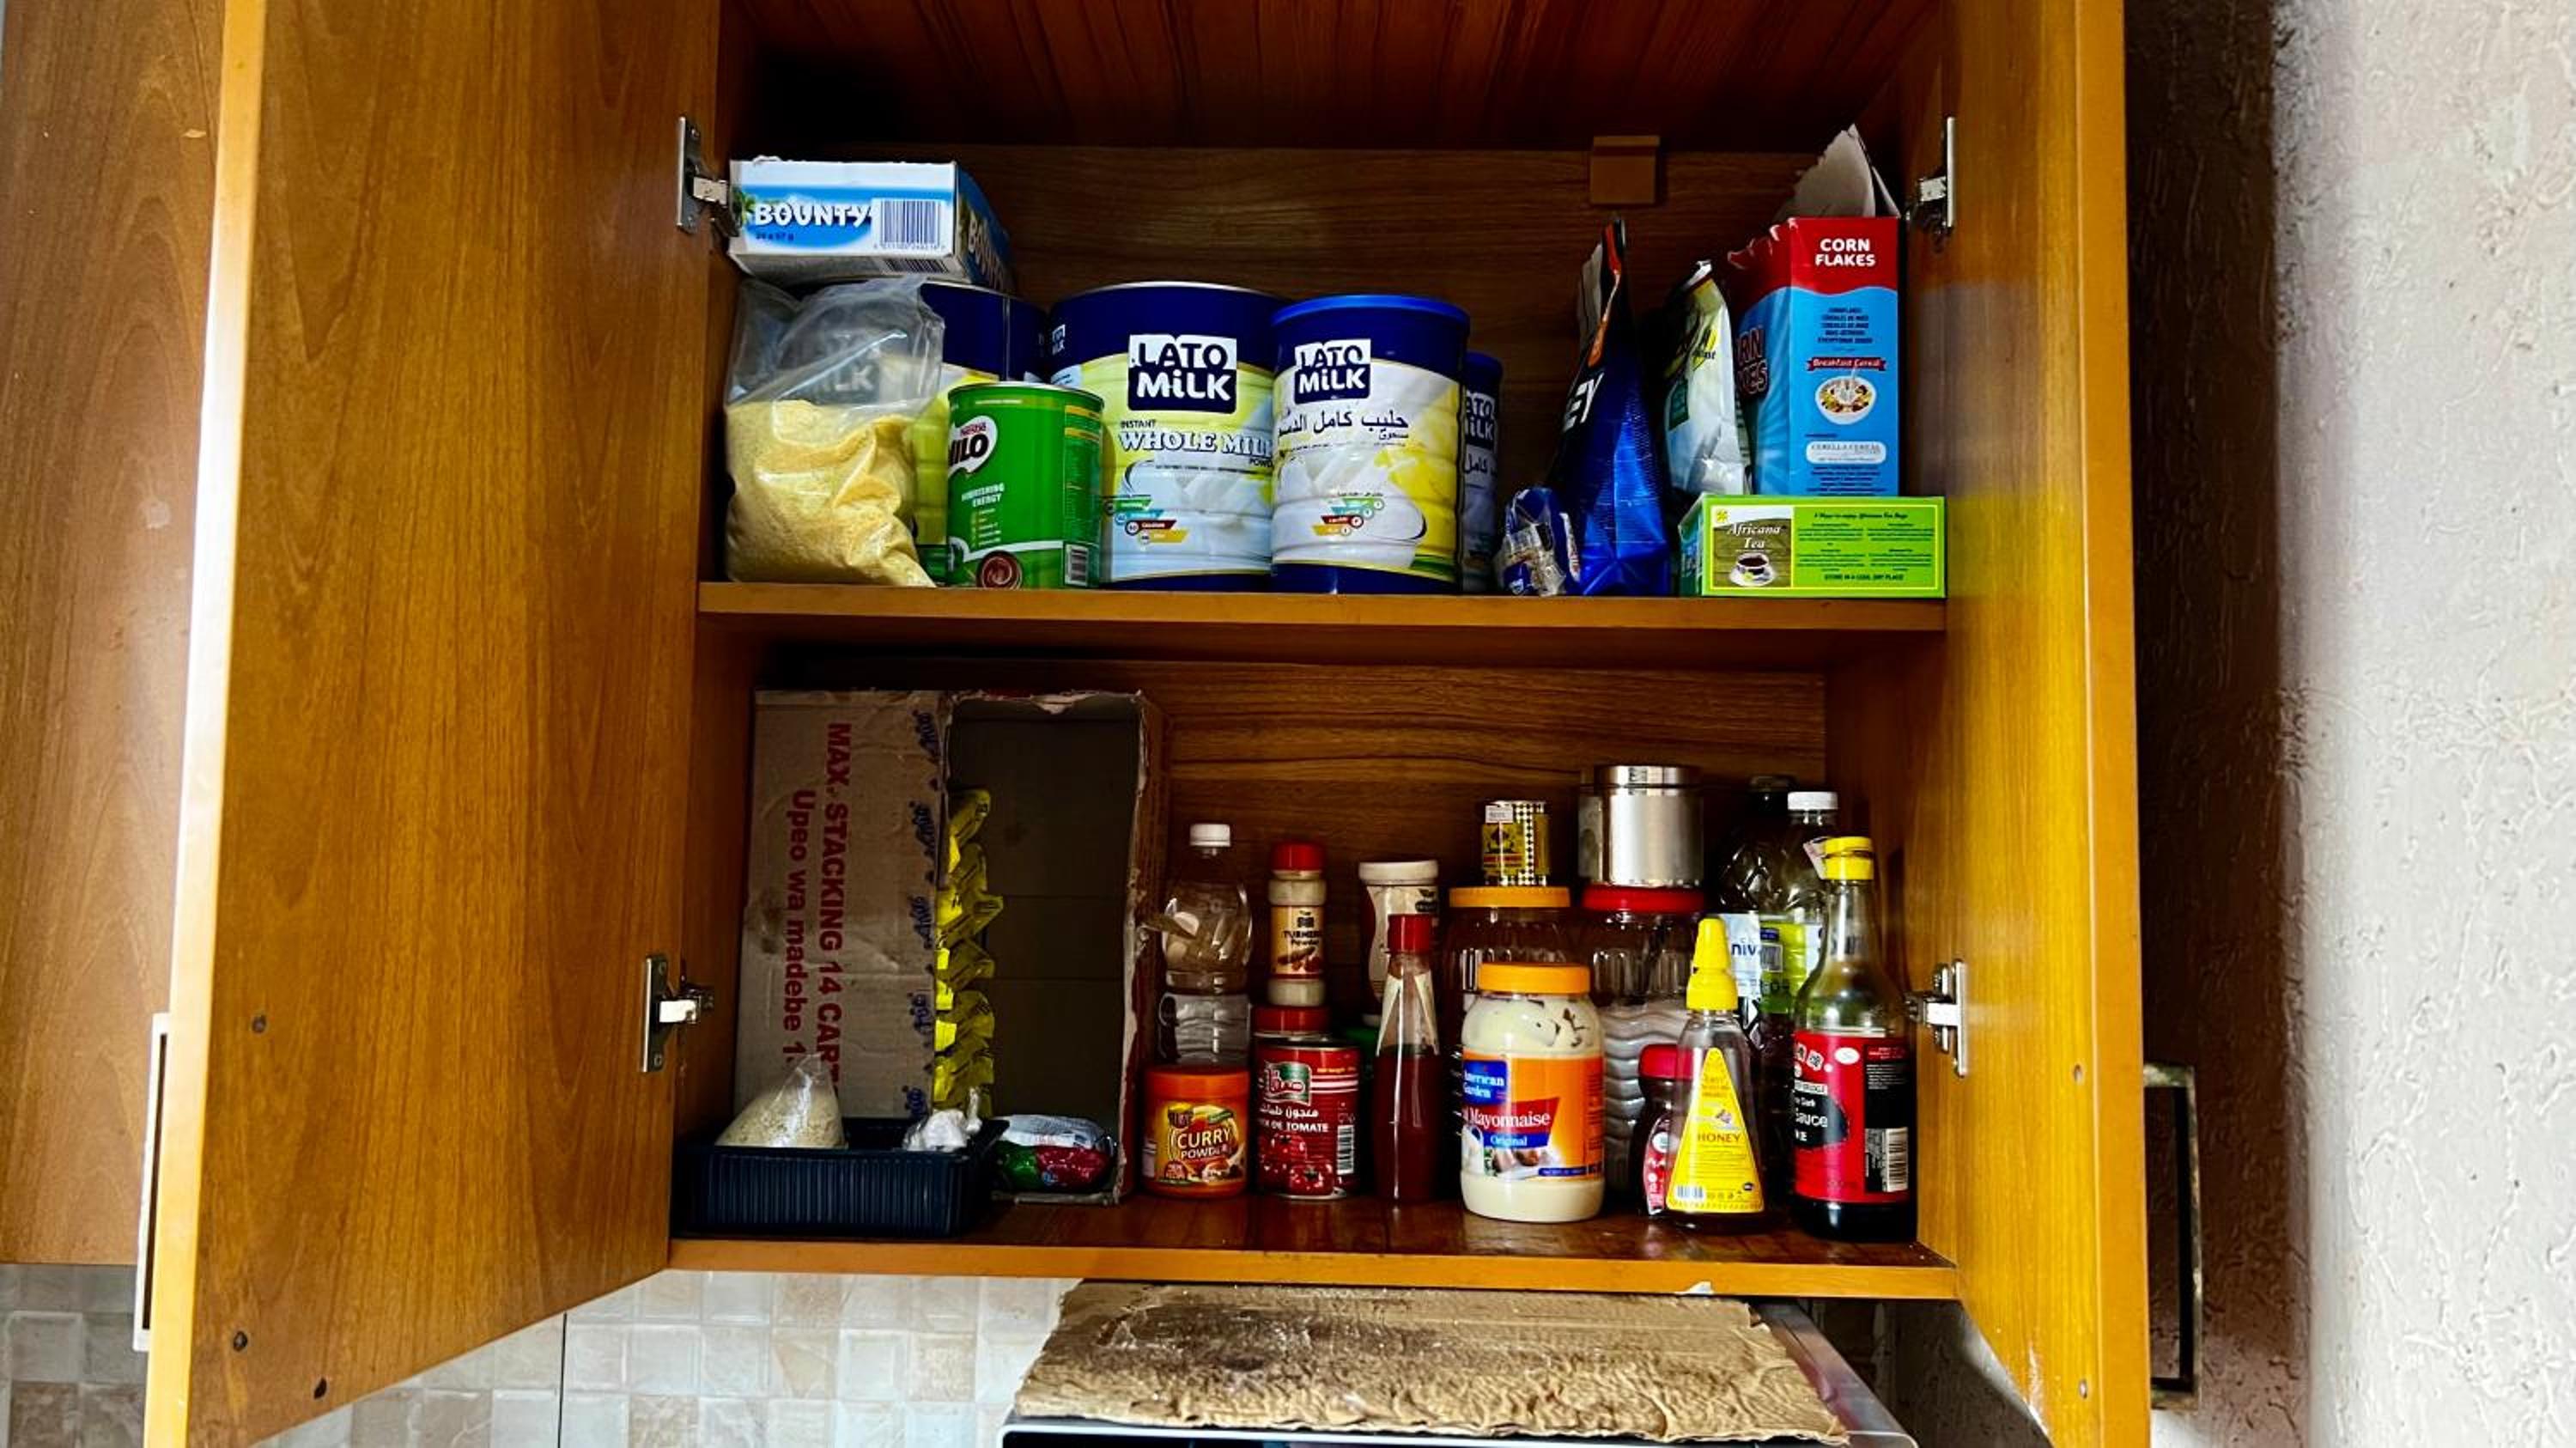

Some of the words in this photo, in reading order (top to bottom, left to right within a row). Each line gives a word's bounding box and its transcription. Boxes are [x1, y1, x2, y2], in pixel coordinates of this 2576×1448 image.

[755, 203, 872, 228] BOUNTY
[1820, 238, 1870, 252] CORN
[1814, 253, 1876, 268] FLAKES
[1138, 343, 1228, 370] LATO
[1299, 344, 1364, 369] LATO
[1121, 419, 1157, 429] INSTANT
[1313, 410, 1353, 434] كامل
[1361, 409, 1409, 432] حليب
[1119, 431, 1217, 453] WHOLE
[1727, 522, 1780, 536] Africana
[1744, 537, 1765, 549] Tea
[826, 722, 853, 798] MAX.
[787, 789, 816, 861] Upeo
[818, 802, 849, 952] STACKING
[787, 869, 806, 911] wa
[783, 920, 808, 1031] madebe
[818, 961, 842, 995] 14
[817, 1002, 842, 1097] CART
[1285, 1122, 1329, 1133] TOMATE
[1469, 1106, 1551, 1129] Mayonnaise
[1177, 1128, 1231, 1149] CURRY
[1698, 1133, 1741, 1143] HONEY
